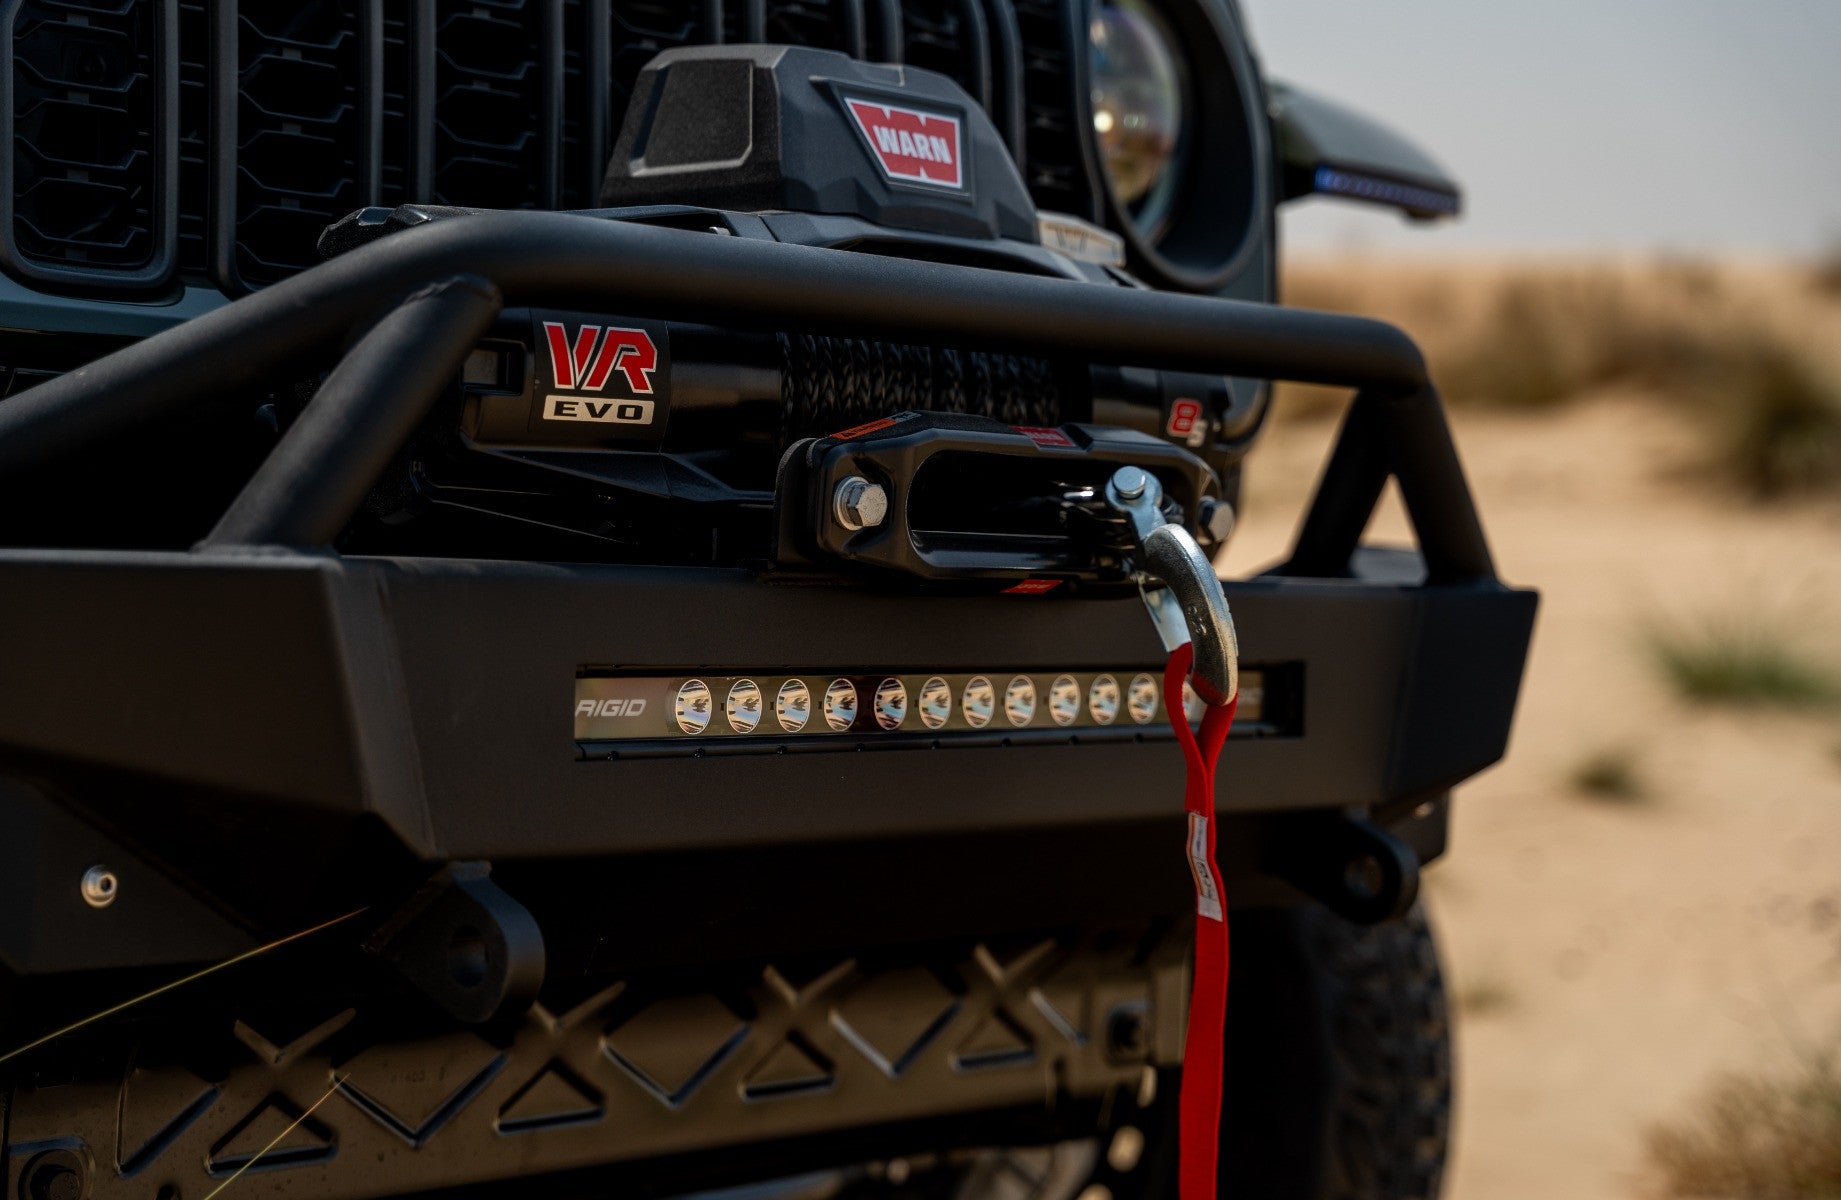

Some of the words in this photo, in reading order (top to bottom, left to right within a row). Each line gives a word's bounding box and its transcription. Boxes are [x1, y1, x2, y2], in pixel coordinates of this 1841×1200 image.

[872, 125, 953, 165] WARN
[543, 321, 657, 394] VR
[554, 400, 643, 420] EVO
[575, 699, 647, 717] RIGID
